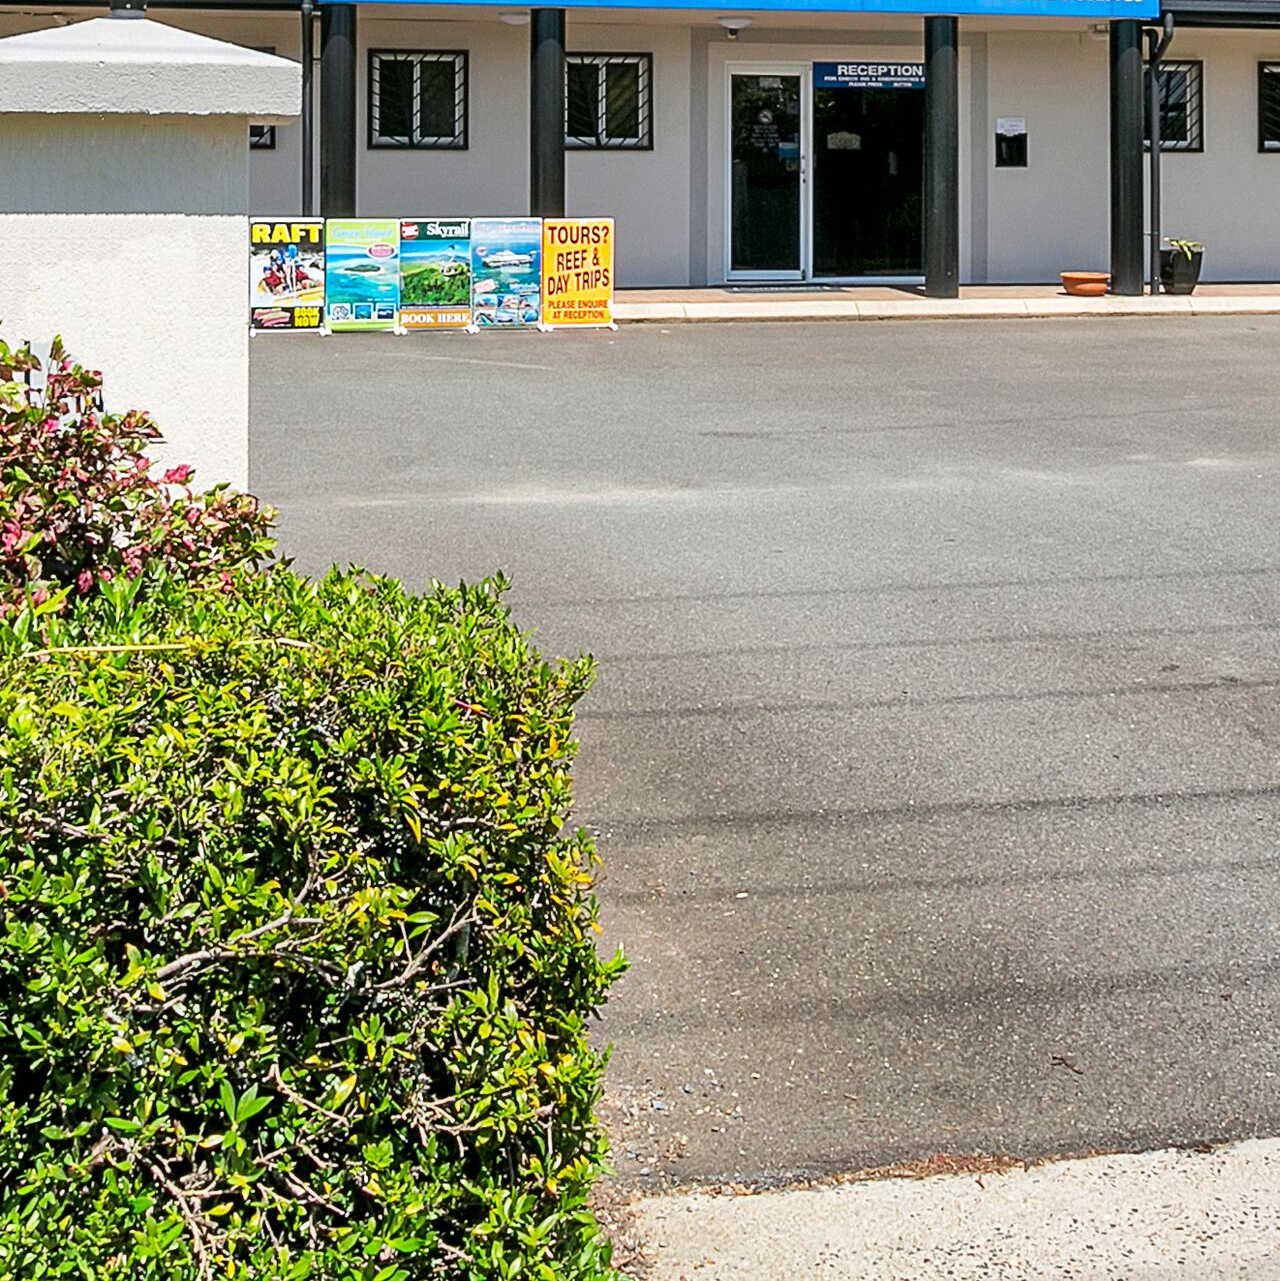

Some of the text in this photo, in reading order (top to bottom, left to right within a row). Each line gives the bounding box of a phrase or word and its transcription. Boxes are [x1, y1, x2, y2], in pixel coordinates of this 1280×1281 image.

[837, 64, 923, 76] RECEPTION
[251, 223, 323, 243] RAFT
[426, 222, 469, 238] Skyrail
[548, 225, 609, 244] TOURS?
[556, 247, 600, 273] REEF &
[548, 274, 570, 295] DAY
[575, 268, 609, 292] TRIPS
[548, 299, 608, 309] PLEASE ENQUIRE
[294, 307, 320, 317] BOOK
[401, 312, 470, 324] BOOK HERE
[553, 310, 604, 319] AT RECEPTION
[294, 317, 320, 327] NOW
